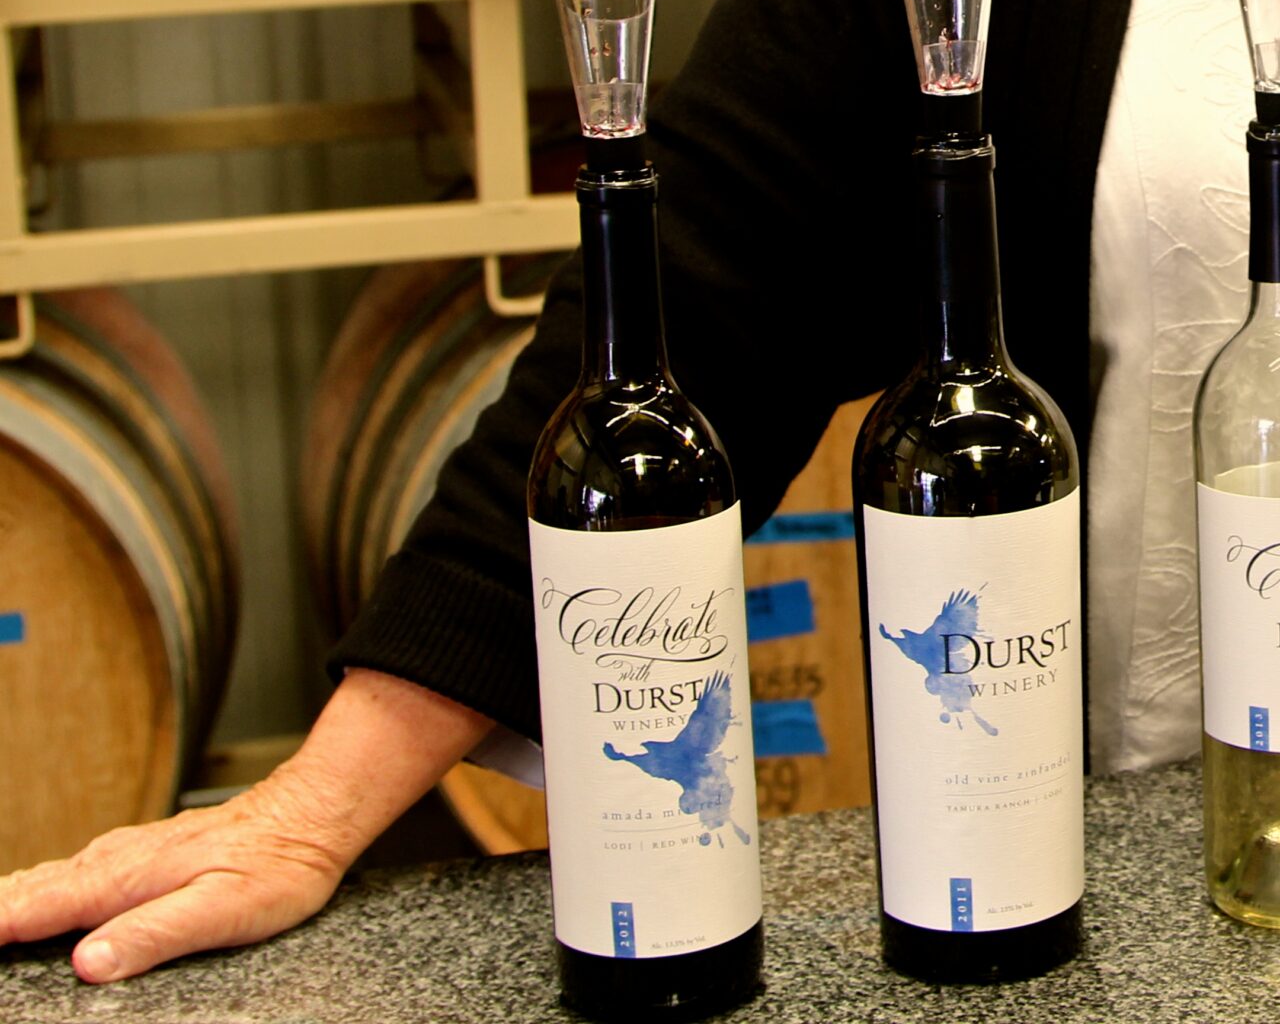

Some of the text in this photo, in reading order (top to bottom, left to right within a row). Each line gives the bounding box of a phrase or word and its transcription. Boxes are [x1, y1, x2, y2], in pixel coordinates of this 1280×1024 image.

[541, 577, 735, 663] Celebrate
[939, 619, 1071, 675] DURST
[618, 658, 653, 682] with
[968, 668, 1058, 698] WINERY
[592, 678, 703, 714] DURST
[613, 714, 687, 731] WINERY
[945, 774, 969, 785] old
[602, 808, 652, 820] amada
[604, 842, 632, 850] LODI
[956, 887, 967, 923] 2011
[618, 911, 630, 948] 2012
